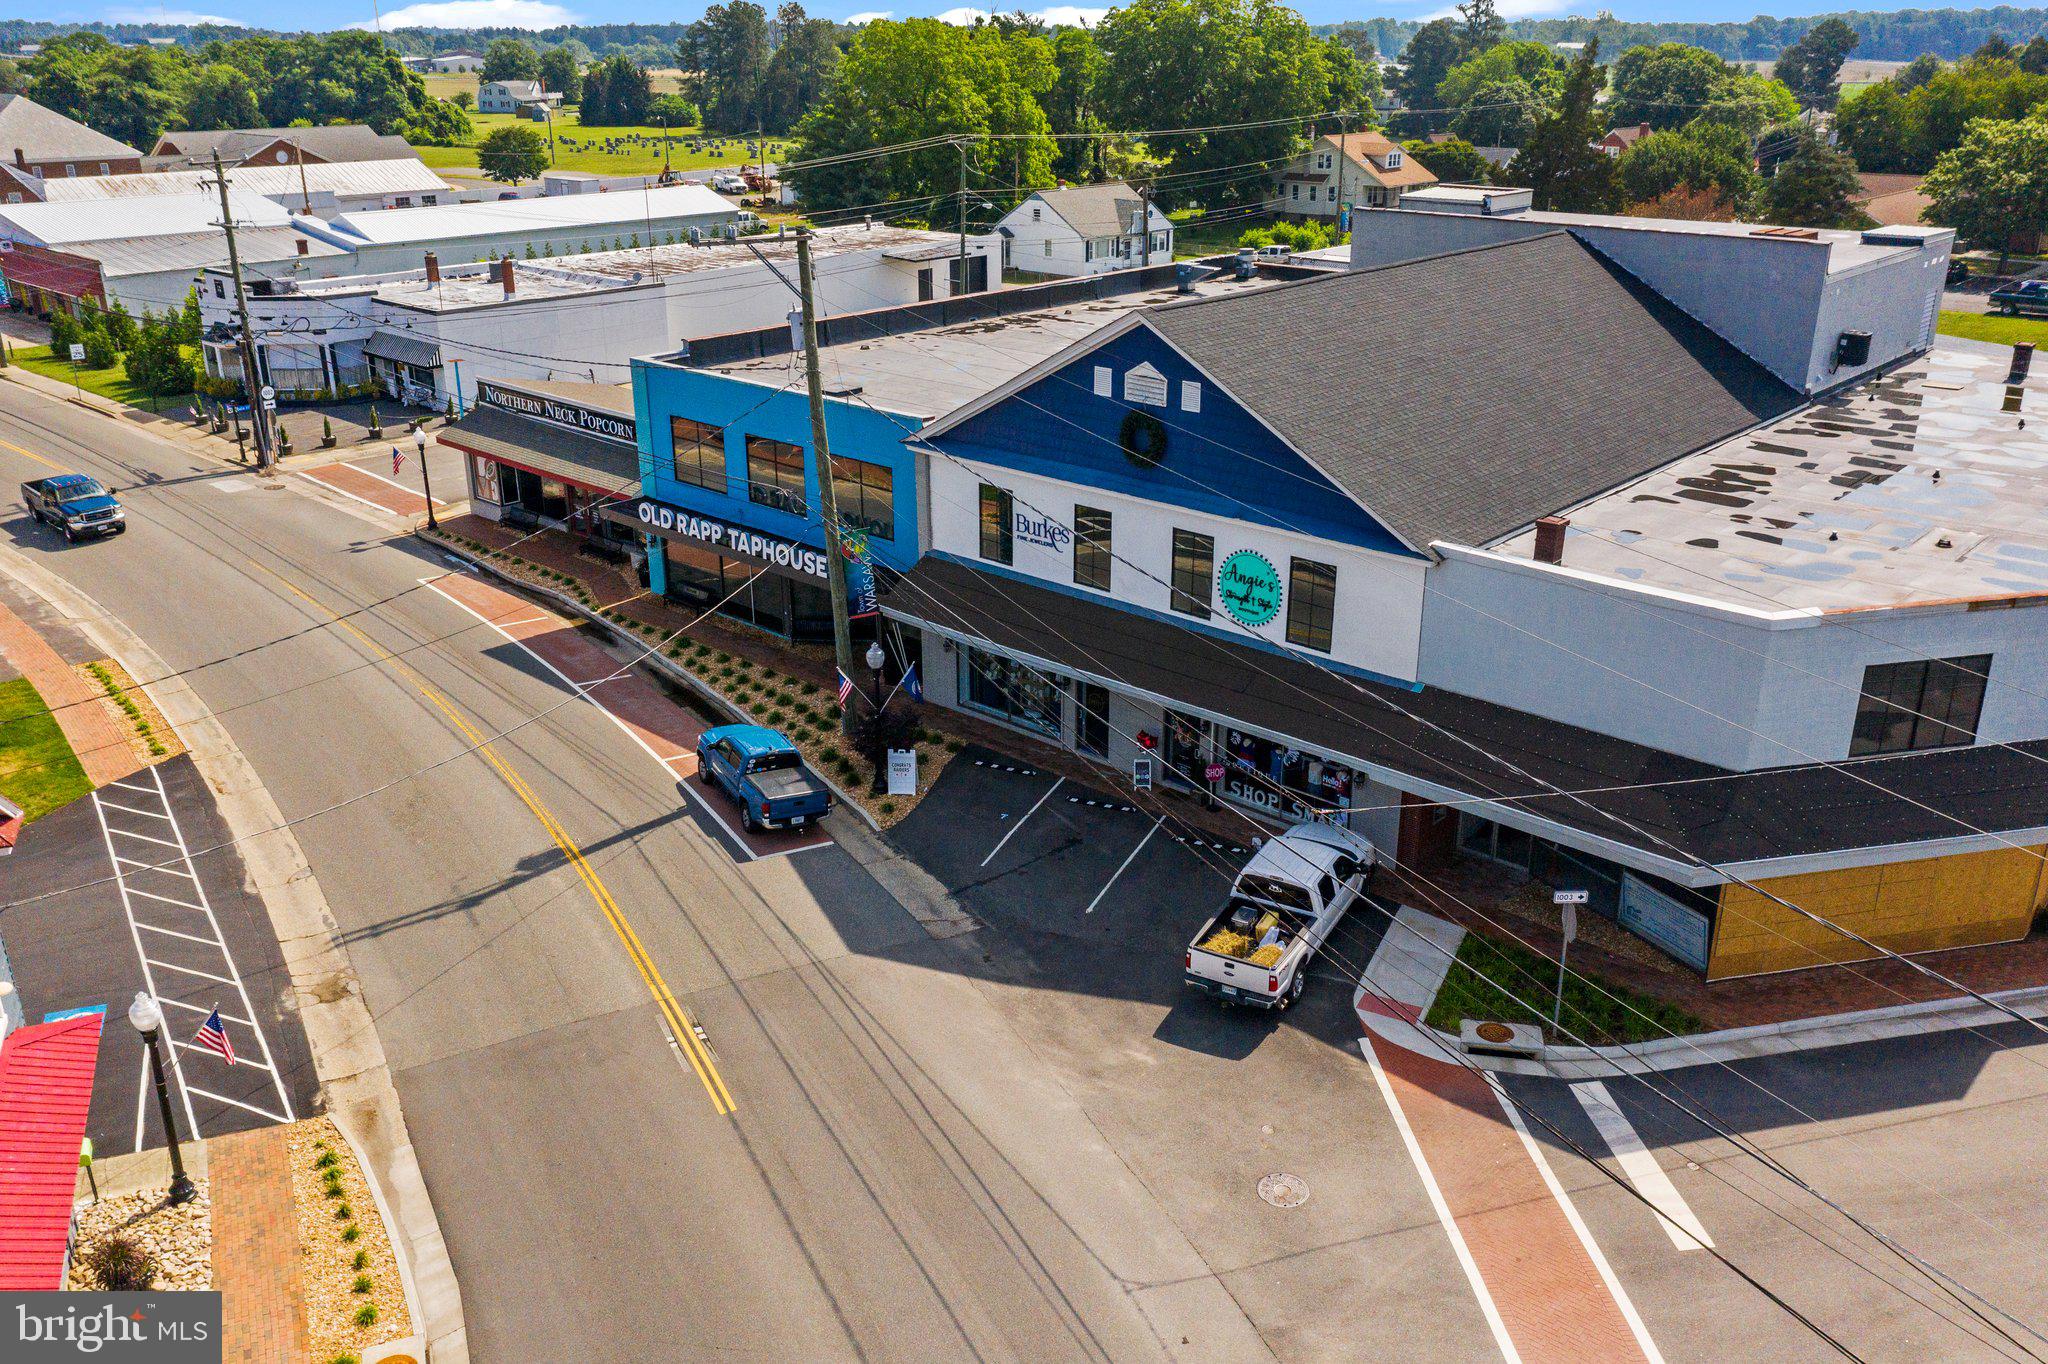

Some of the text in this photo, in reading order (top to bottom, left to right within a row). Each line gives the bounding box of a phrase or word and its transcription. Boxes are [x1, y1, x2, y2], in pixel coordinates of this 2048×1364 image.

[485, 386, 633, 439] NORTHERN NECK POPCORN
[638, 502, 828, 578] OLD RAPP TAPHOUSE
[1016, 513, 1070, 553] Burkes
[1224, 563, 1275, 595] Angie's
[1205, 767, 1224, 778] SHOP
[1229, 781, 1279, 809] SHOP
